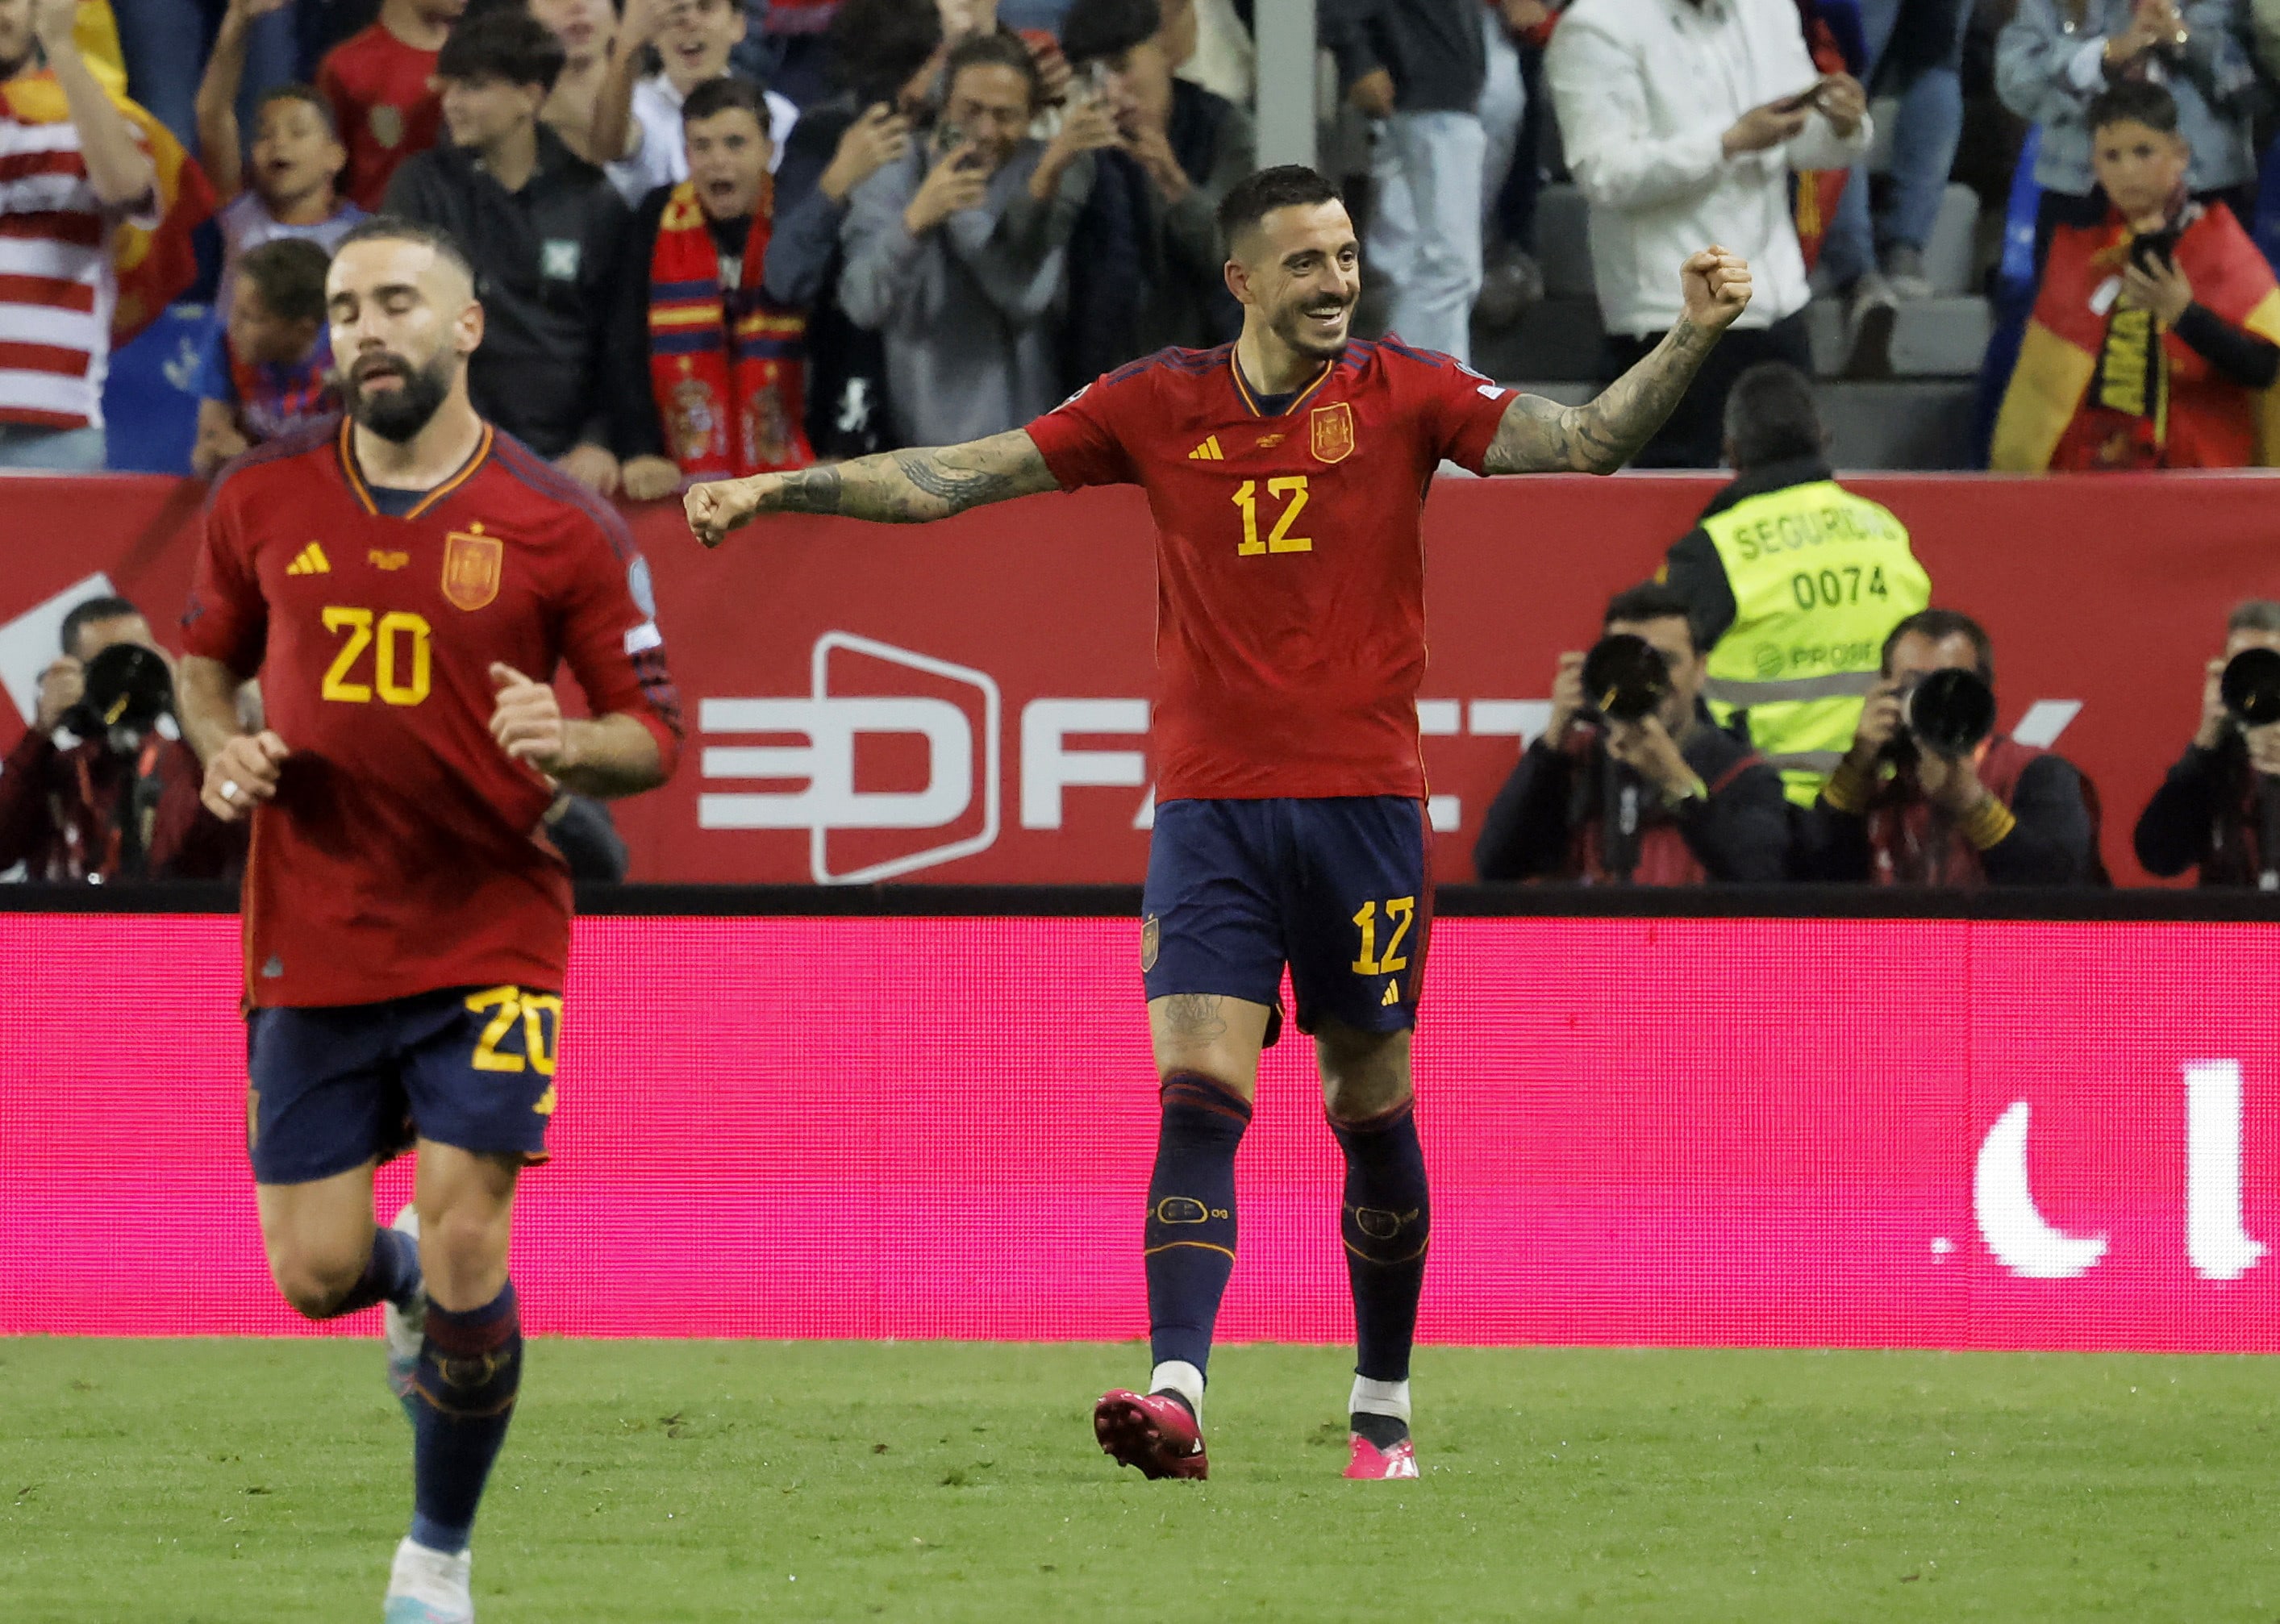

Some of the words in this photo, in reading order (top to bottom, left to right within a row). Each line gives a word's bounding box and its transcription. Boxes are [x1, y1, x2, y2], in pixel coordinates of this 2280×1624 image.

[1232, 476, 1312, 556] 12
[1792, 566, 1888, 610] 0074
[322, 606, 431, 706] 20
[1353, 896, 1415, 976] 12
[465, 985, 564, 1076] 20
